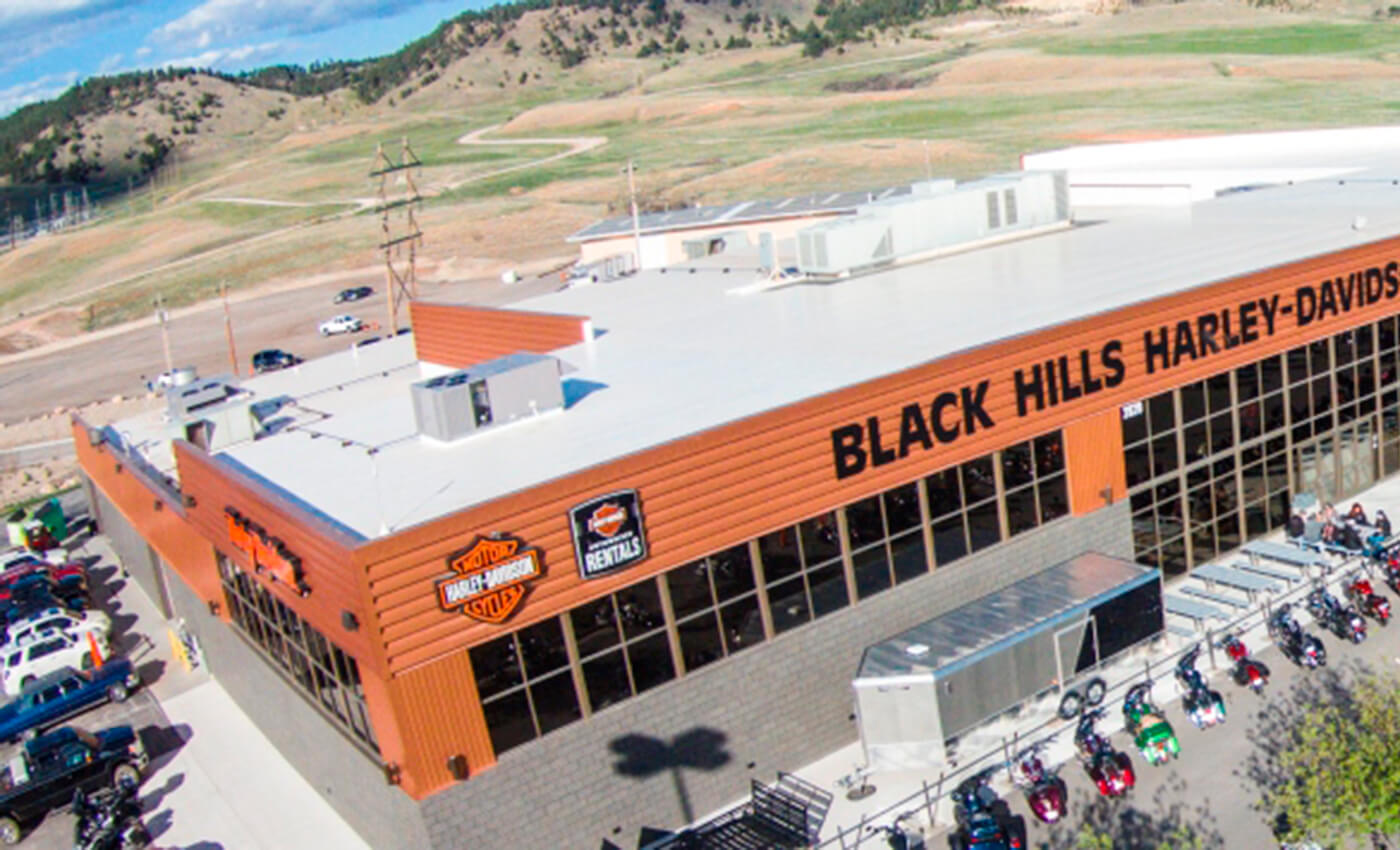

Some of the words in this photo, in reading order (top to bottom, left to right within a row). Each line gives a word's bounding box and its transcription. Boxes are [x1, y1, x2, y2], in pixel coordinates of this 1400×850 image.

[831, 379, 996, 481] BLACK
[1013, 340, 1126, 418] HILLS
[452, 541, 518, 574] MOTOR
[585, 536, 642, 573] RENTALS
[444, 554, 535, 604] HARLEY-DAVIDSON
